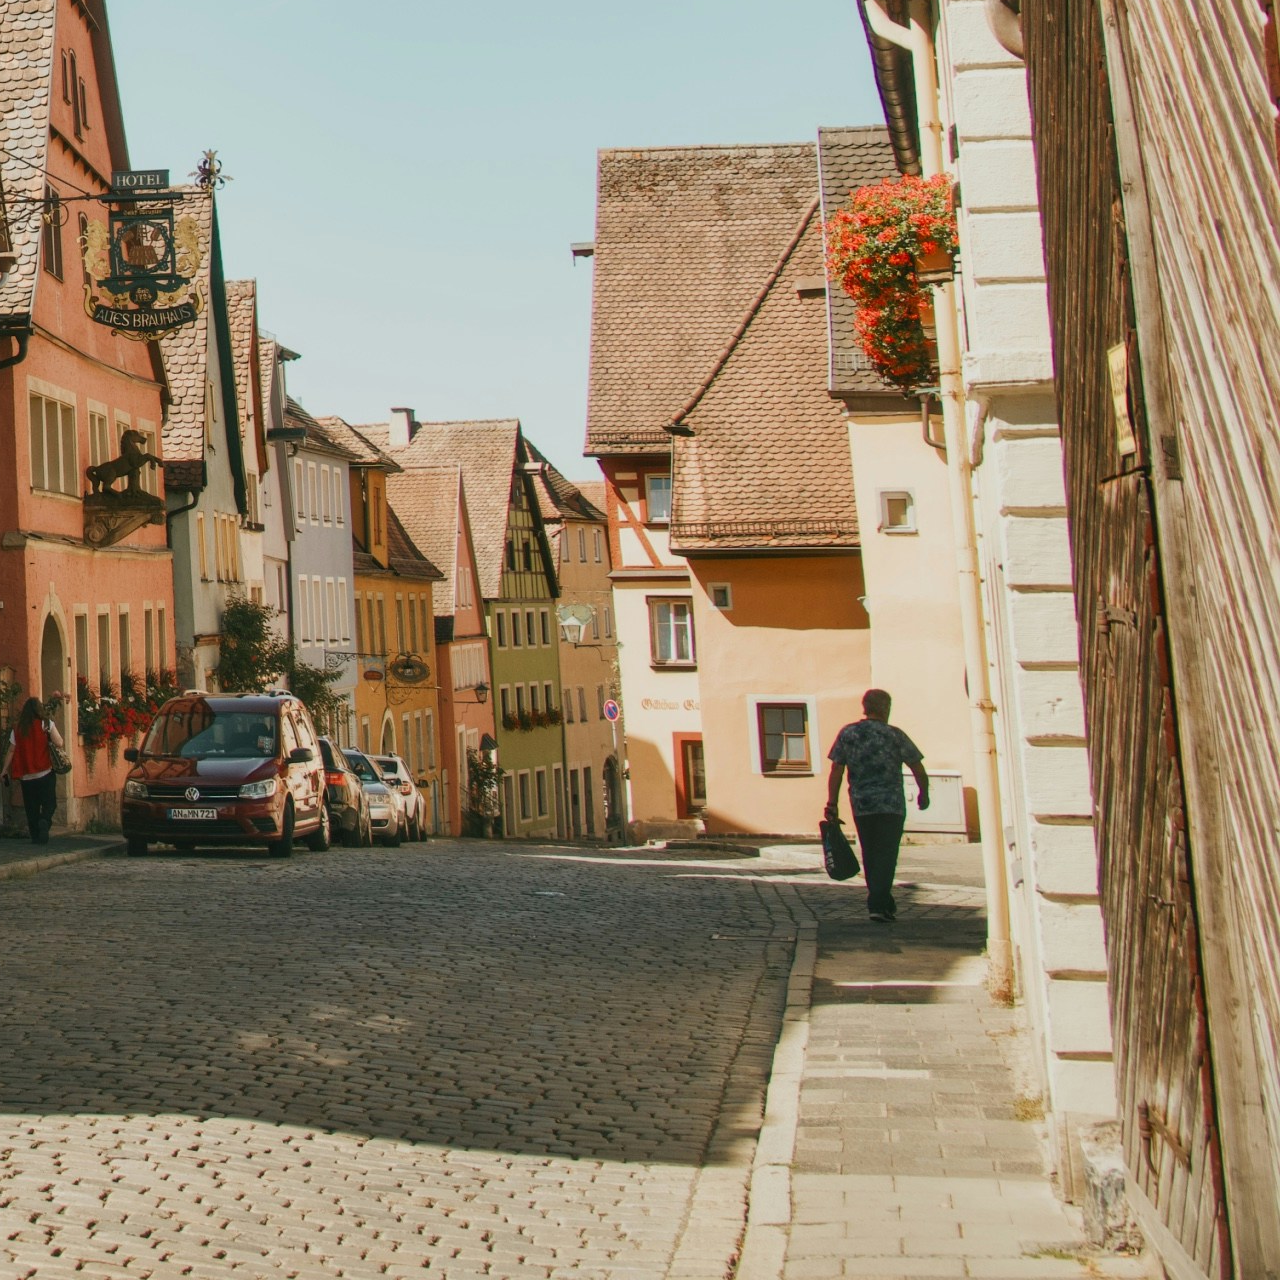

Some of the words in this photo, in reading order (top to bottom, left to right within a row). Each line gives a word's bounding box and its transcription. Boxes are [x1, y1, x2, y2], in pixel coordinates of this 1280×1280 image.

[116, 174, 164, 187] HOTEL
[95, 309, 130, 327] ALTES
[132, 305, 191, 328] BRAUHAUS
[172, 809, 183, 818] AN
[200, 809, 215, 819] 721
